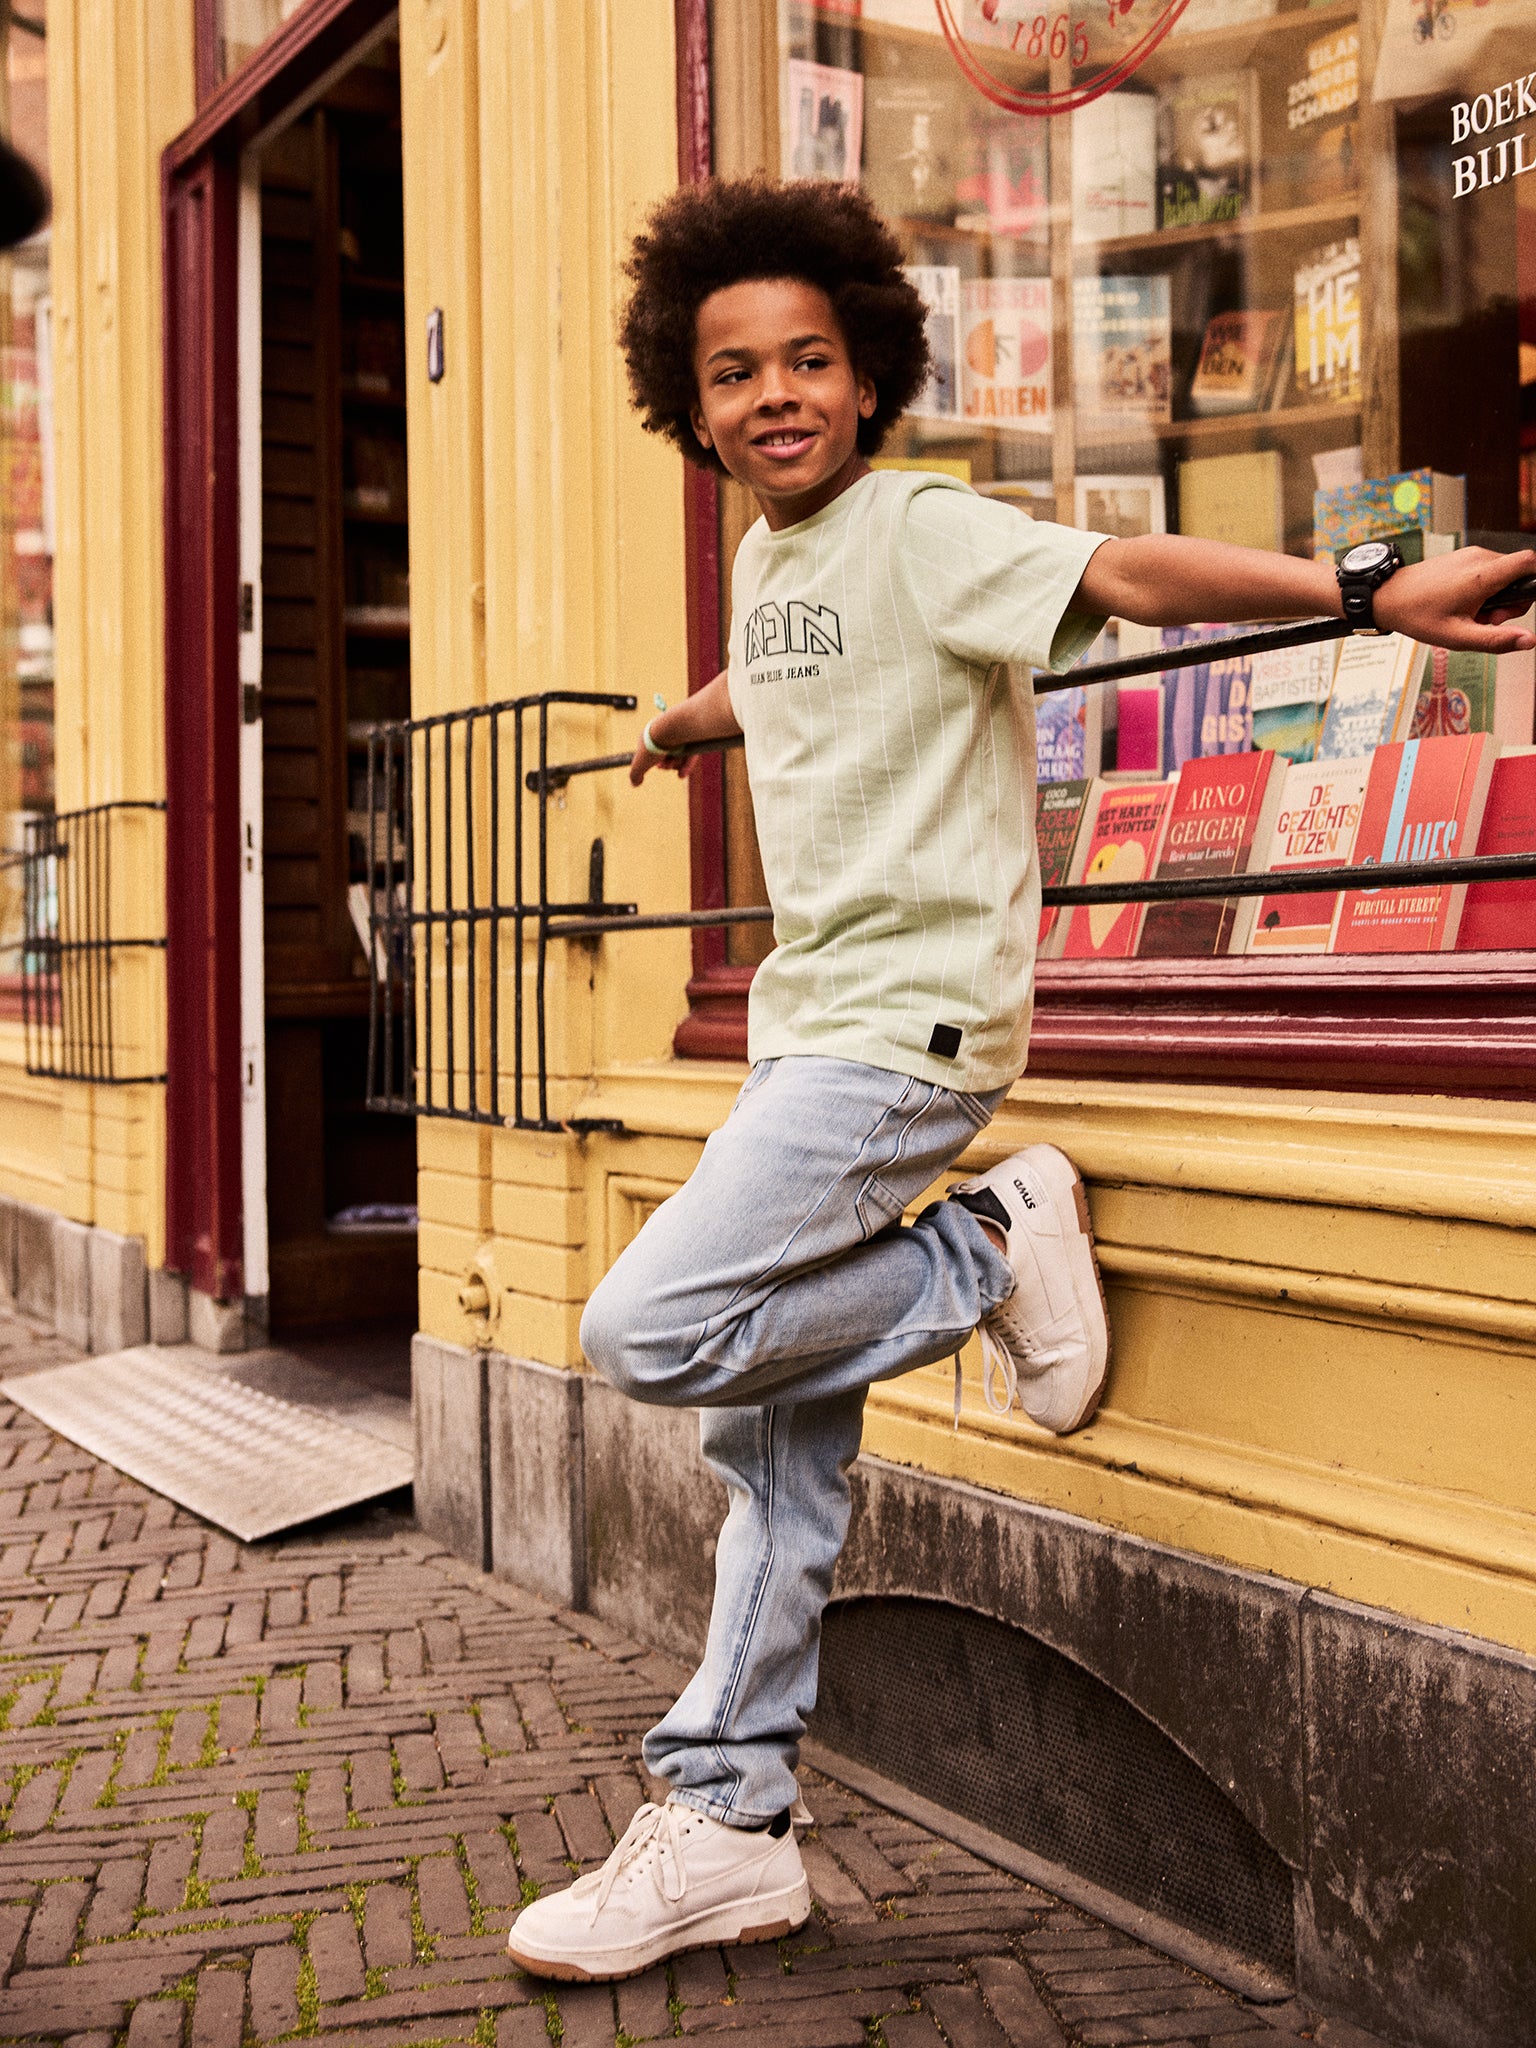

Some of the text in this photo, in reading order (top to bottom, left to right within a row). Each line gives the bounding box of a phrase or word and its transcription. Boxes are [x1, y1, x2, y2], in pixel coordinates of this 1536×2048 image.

[1010, 14, 1088, 67] 1865
[1450, 71, 1536, 145] BOEK
[1451, 133, 1536, 199] BIJL
[964, 385, 1048, 418] JAREN
[787, 664, 820, 680] JEANS
[1185, 783, 1245, 812] ARNO
[1309, 784, 1335, 808] DE
[1112, 818, 1158, 835] WINTER
[1119, 804, 1150, 820] HART
[1277, 803, 1359, 834] GEZICHTS
[1170, 816, 1246, 846] GEIGER
[1285, 830, 1339, 857] LOZEN
[1353, 896, 1442, 916] PERCIVAL EVERETT
